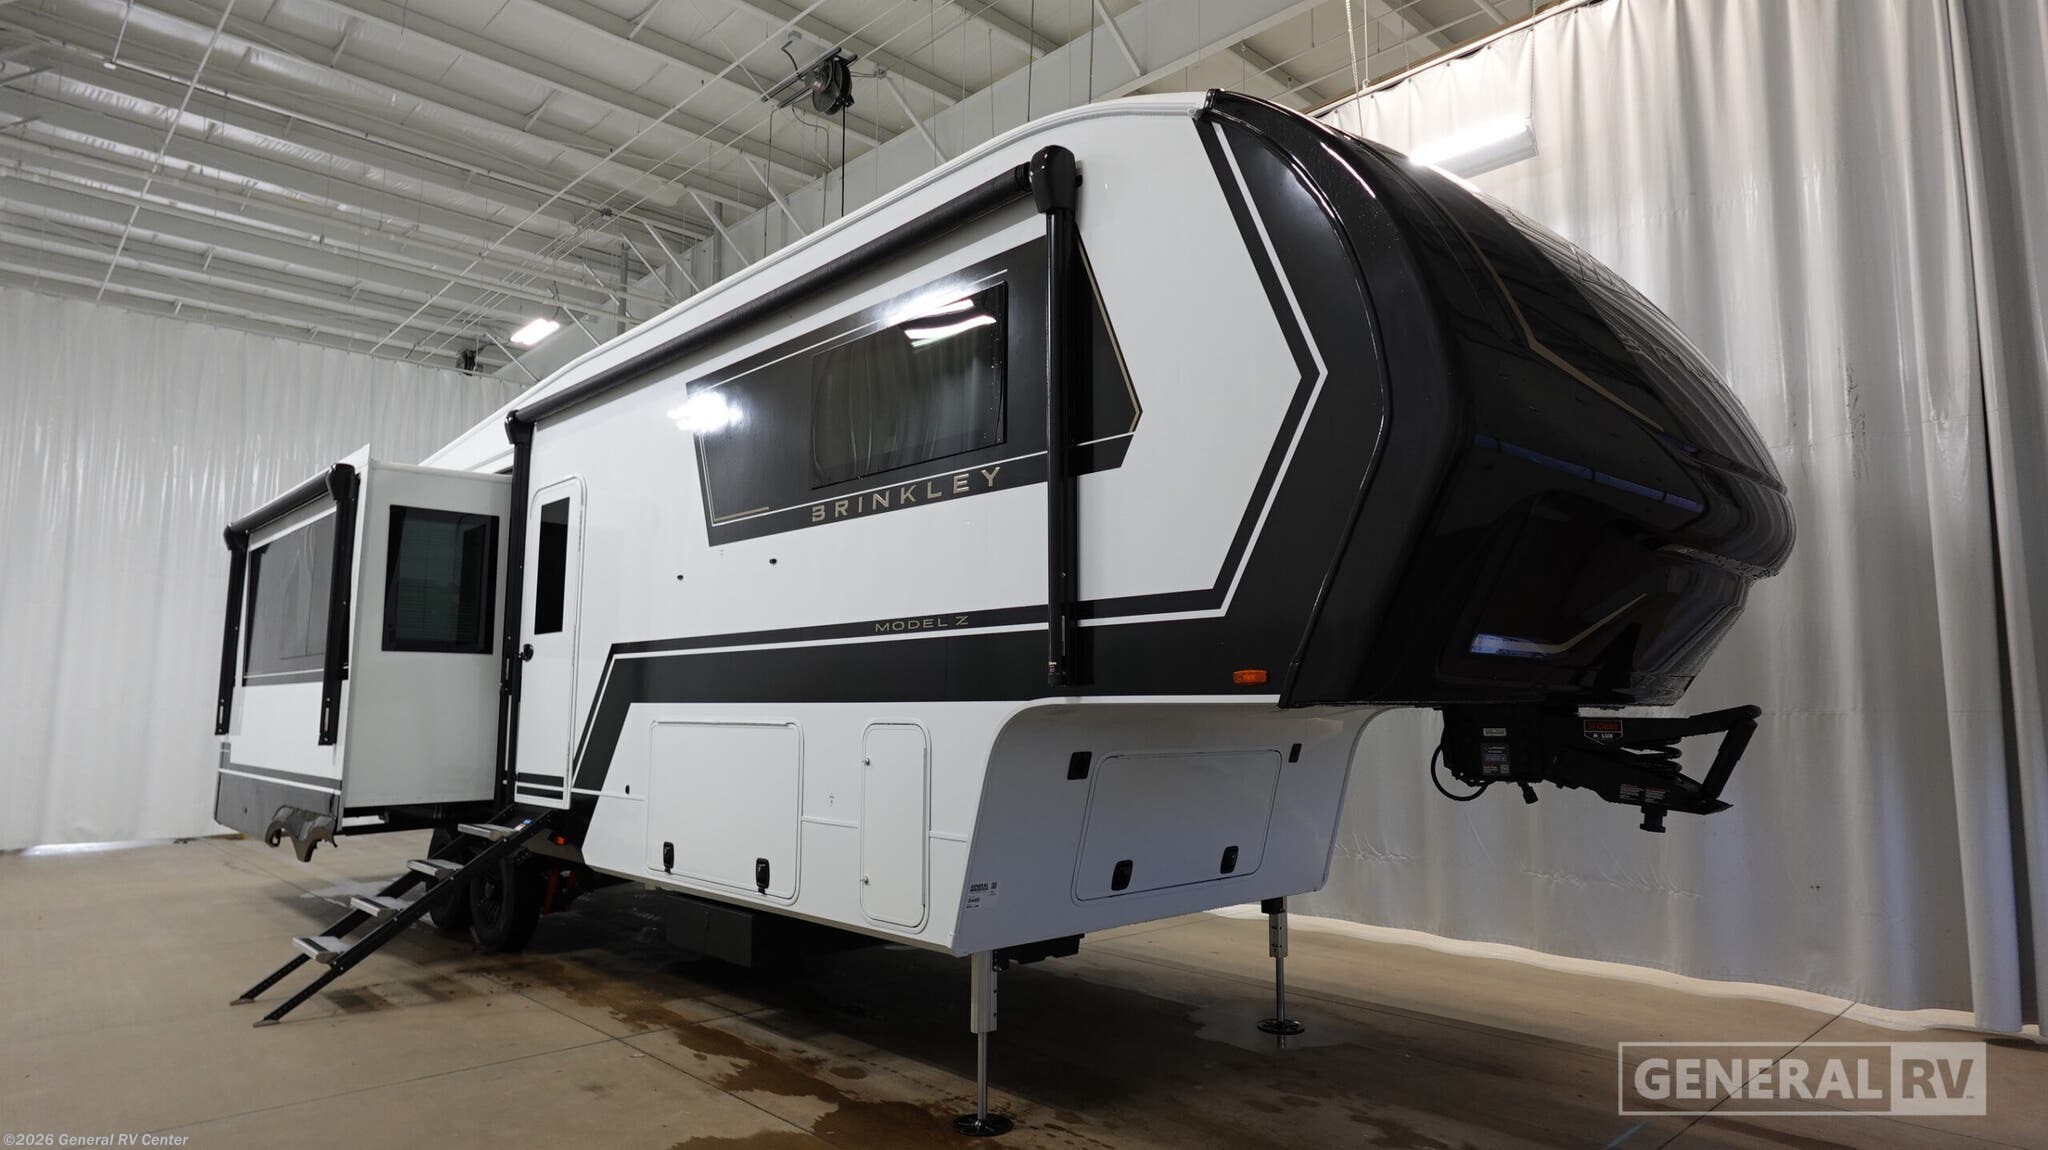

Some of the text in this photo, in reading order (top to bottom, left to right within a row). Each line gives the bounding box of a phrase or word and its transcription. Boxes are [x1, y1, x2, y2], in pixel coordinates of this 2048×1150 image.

[812, 466, 1001, 522] BRINKLEY
[875, 615, 969, 632] MODEL Z
